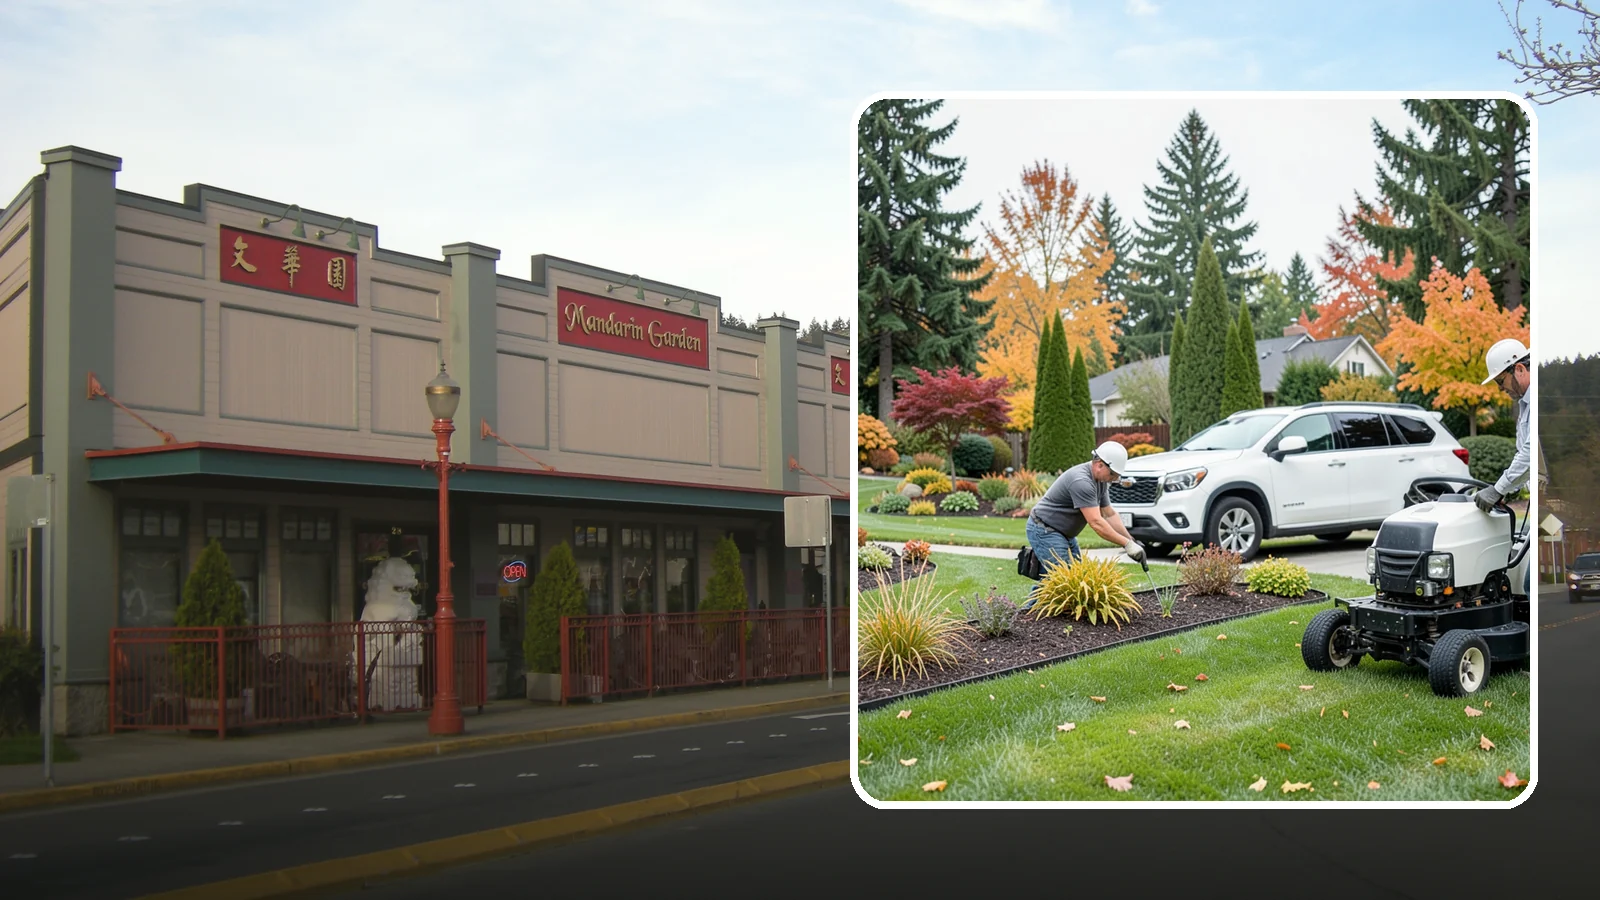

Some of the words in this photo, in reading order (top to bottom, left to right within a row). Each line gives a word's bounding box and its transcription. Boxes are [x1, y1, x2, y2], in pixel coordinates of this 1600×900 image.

[231, 236, 346, 291] 文華園
[564, 302, 644, 341] Mandarin
[647, 320, 702, 352] Garden
[504, 565, 526, 578] OPEN
